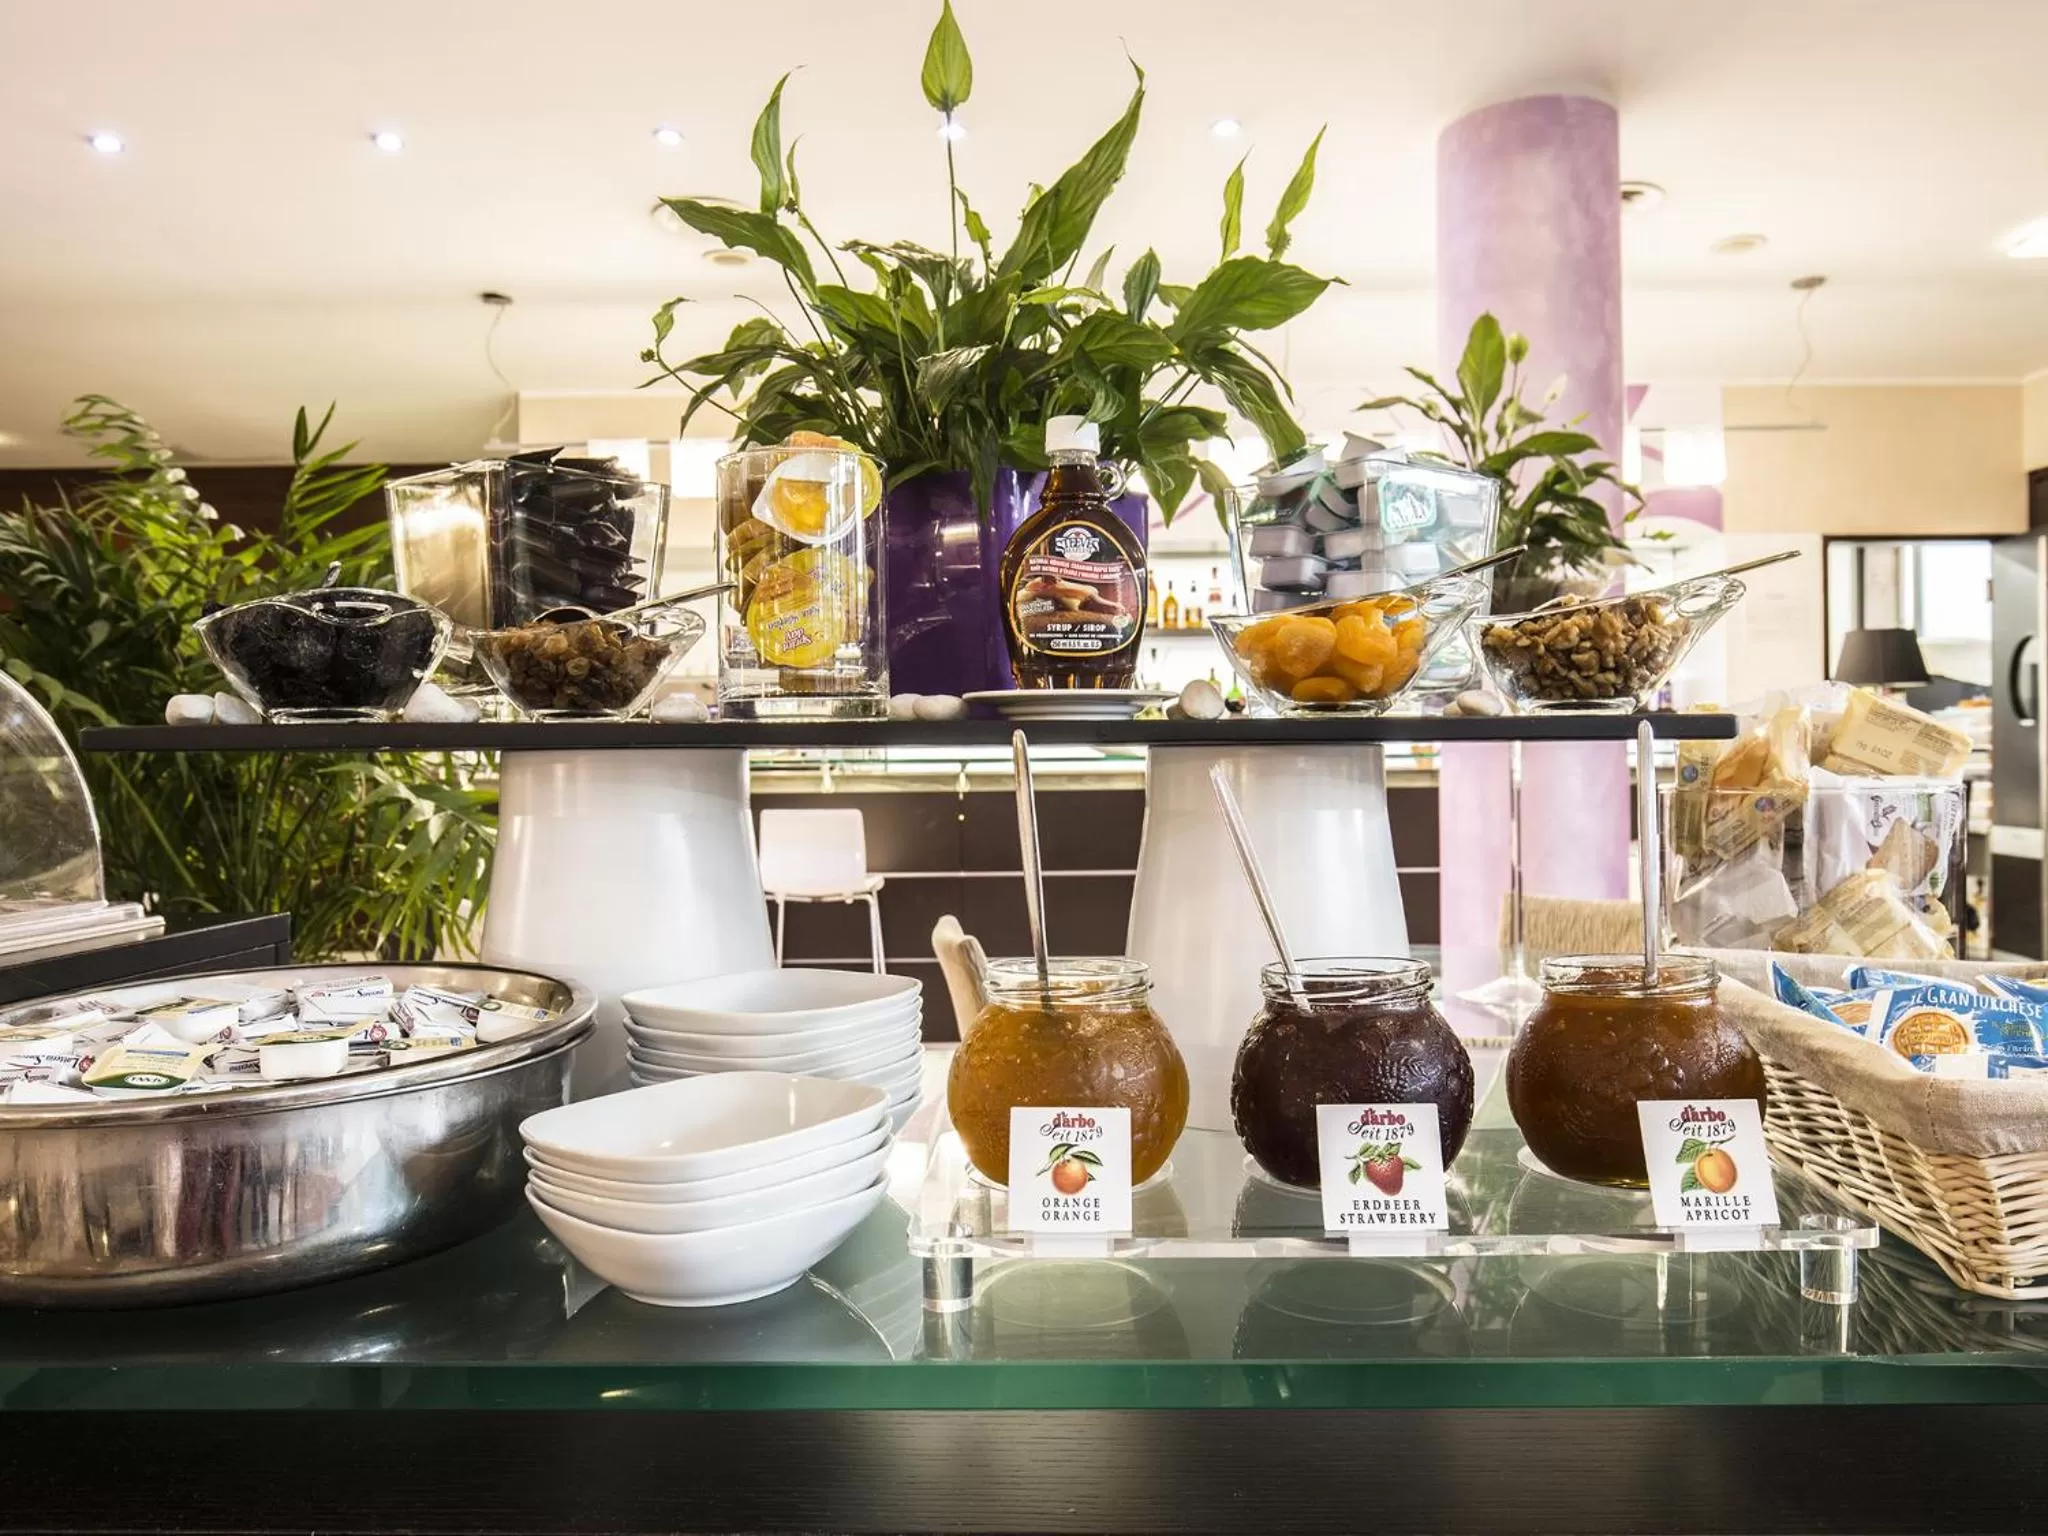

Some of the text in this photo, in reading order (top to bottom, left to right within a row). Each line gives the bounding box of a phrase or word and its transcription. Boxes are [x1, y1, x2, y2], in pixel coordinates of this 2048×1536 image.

[1046, 623, 1073, 632] SYRUP
[1083, 623, 1107, 632] SIROP
[1039, 1123, 1104, 1142] Seit 1879
[1347, 1121, 1415, 1141] Seit 1879
[1669, 1117, 1737, 1137] Seit 1879
[1041, 1197, 1101, 1208] ORANGE
[1352, 1199, 1422, 1210] ERDBEER
[1680, 1195, 1752, 1207] MARILLE
[1041, 1211, 1101, 1221] ORANGE
[1339, 1212, 1437, 1224] STRAWBERRY
[1686, 1209, 1752, 1221] APRICOT
